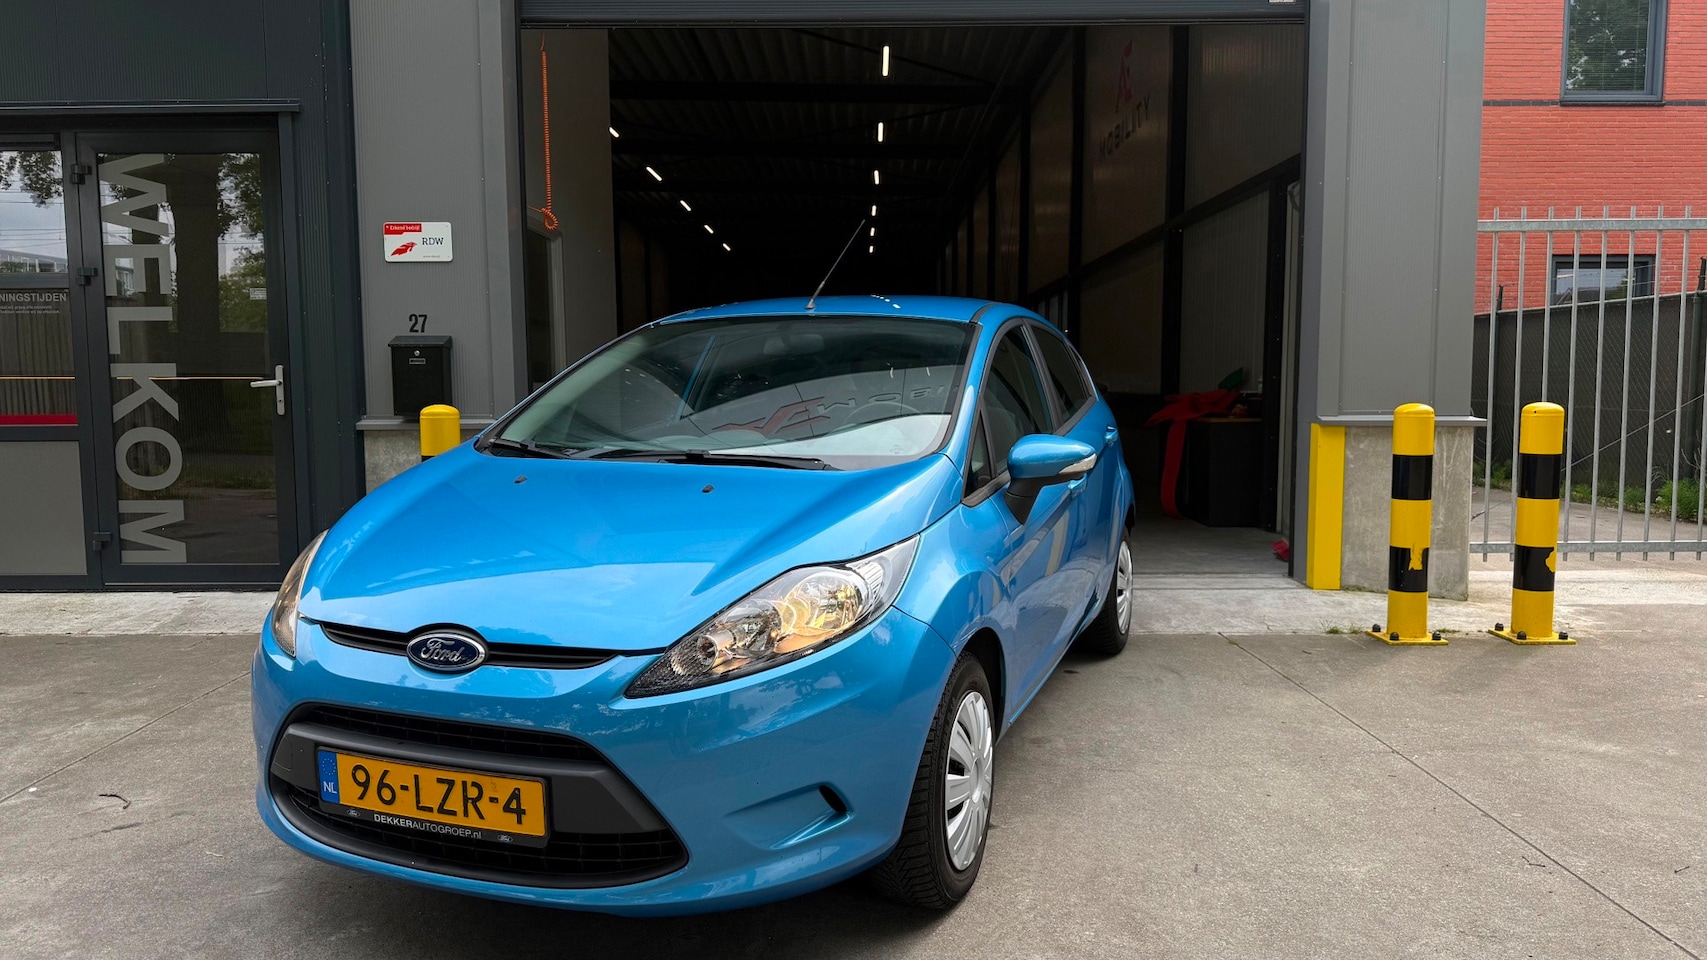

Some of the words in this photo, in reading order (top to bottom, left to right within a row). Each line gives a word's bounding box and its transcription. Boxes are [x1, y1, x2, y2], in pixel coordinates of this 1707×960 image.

[1099, 91, 1151, 160] MOBILITY
[422, 237, 444, 245] RDW
[408, 313, 428, 333] 27
[99, 153, 187, 563] WELKOM
[420, 638, 465, 662] Ford
[322, 781, 337, 794] NL
[351, 764, 527, 825] 96-LZR-4
